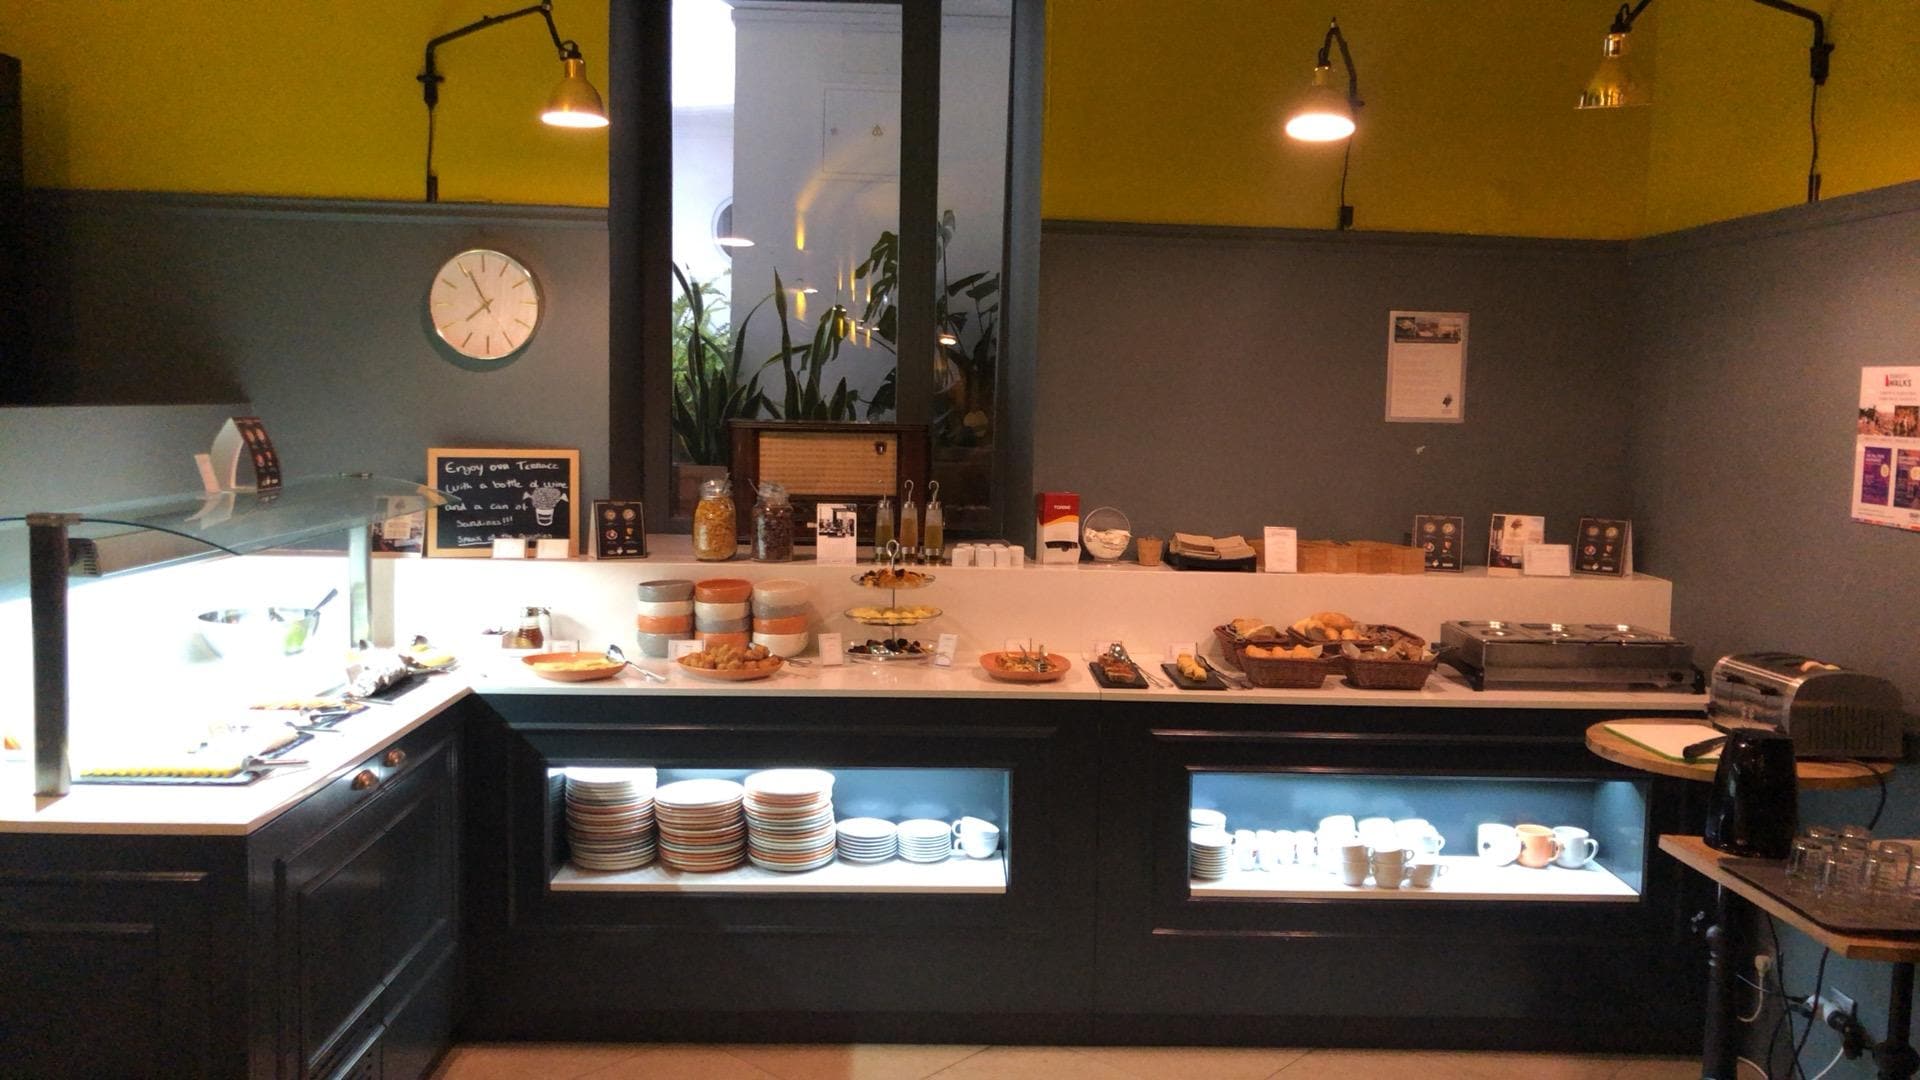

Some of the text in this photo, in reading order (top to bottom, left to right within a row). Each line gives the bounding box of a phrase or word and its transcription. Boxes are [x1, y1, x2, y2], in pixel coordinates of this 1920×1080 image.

[445, 461, 483, 476] Enjoy
[492, 478, 524, 489] bottle
[529, 480, 540, 488] of
[542, 480, 568, 489] wine
[444, 503, 467, 511] and
[515, 503, 529, 511] of
